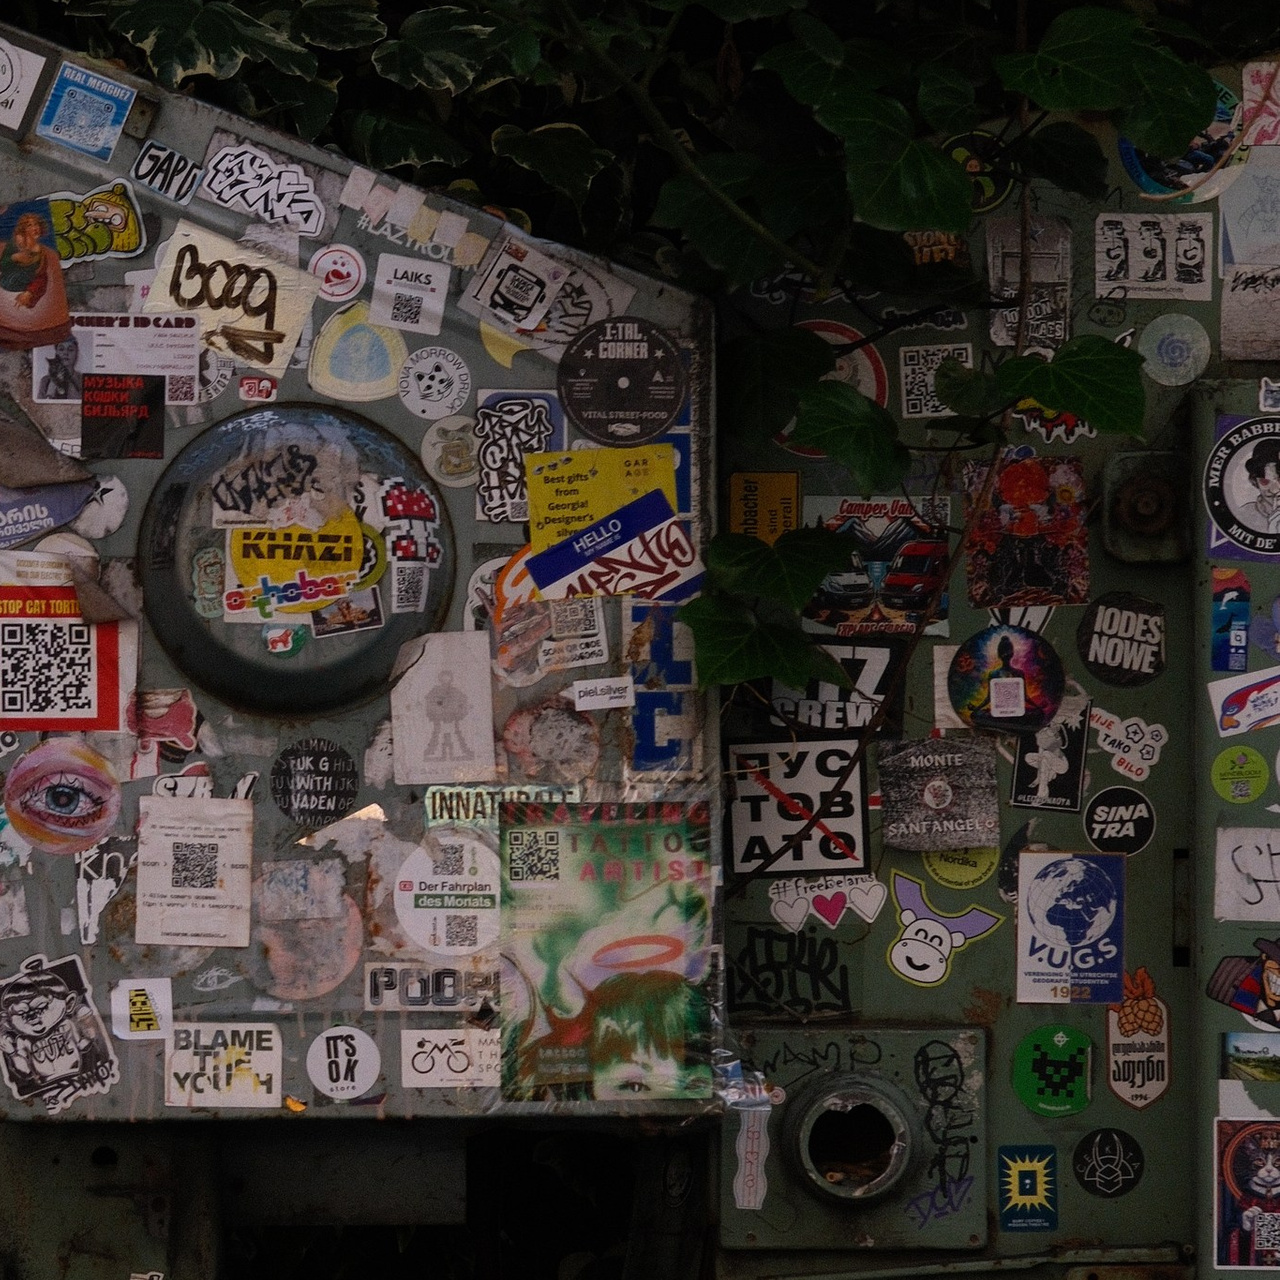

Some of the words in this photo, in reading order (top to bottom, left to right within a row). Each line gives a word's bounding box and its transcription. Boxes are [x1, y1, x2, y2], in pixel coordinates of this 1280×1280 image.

[63, 68, 87, 85] REAL
[86, 75, 130, 101] MERGUEZ
[393, 268, 432, 285] LAIKS
[153, 317, 196, 328] CARD
[599, 342, 648, 359] CORNER
[84, 376, 145, 389] МУЗЫКА
[410, 349, 464, 373] MORROW
[447, 373, 469, 413] DRUCK
[84, 390, 130, 404] КОШКИ
[83, 405, 150, 419] БИЛЬЯРД
[582, 411, 609, 419] VITAL
[1209, 449, 1230, 489] MER
[544, 475, 565, 484] Best
[567, 473, 589, 485] gifts
[555, 487, 579, 496] from
[548, 500, 588, 512] Georgia!
[839, 499, 888, 517] Camper
[891, 499, 916, 517] Van
[544, 512, 594, 525] Designer's
[572, 519, 622, 554] HELLO
[1228, 522, 1254, 549] MIT
[242, 531, 353, 561] KHAZI
[25, 600, 46, 614] CAT
[1094, 605, 1162, 644] IODES
[1089, 634, 1159, 673] NOWE
[1102, 733, 1131, 754] TAKO
[737, 749, 851, 780] ПУС
[910, 754, 963, 767] MONTE
[1116, 758, 1144, 777] BILO
[292, 795, 336, 811] VADEN
[741, 791, 854, 821] ТОВ
[509, 805, 710, 824] TRAVELING
[1094, 803, 1149, 822] SINA
[1092, 821, 1135, 840] TRA
[741, 832, 856, 863] АТО
[939, 854, 978, 868] Nordika
[580, 860, 705, 881] ARTIST
[419, 882, 438, 891] Der
[441, 881, 491, 893] Fahrplan
[420, 896, 442, 907] des
[444, 897, 491, 907] Monats
[1051, 986, 1091, 999] 1922
[174, 1030, 273, 1051] BLAME
[326, 1034, 356, 1059] IT'S
[328, 1059, 358, 1083] OK
[330, 1085, 357, 1093] store
